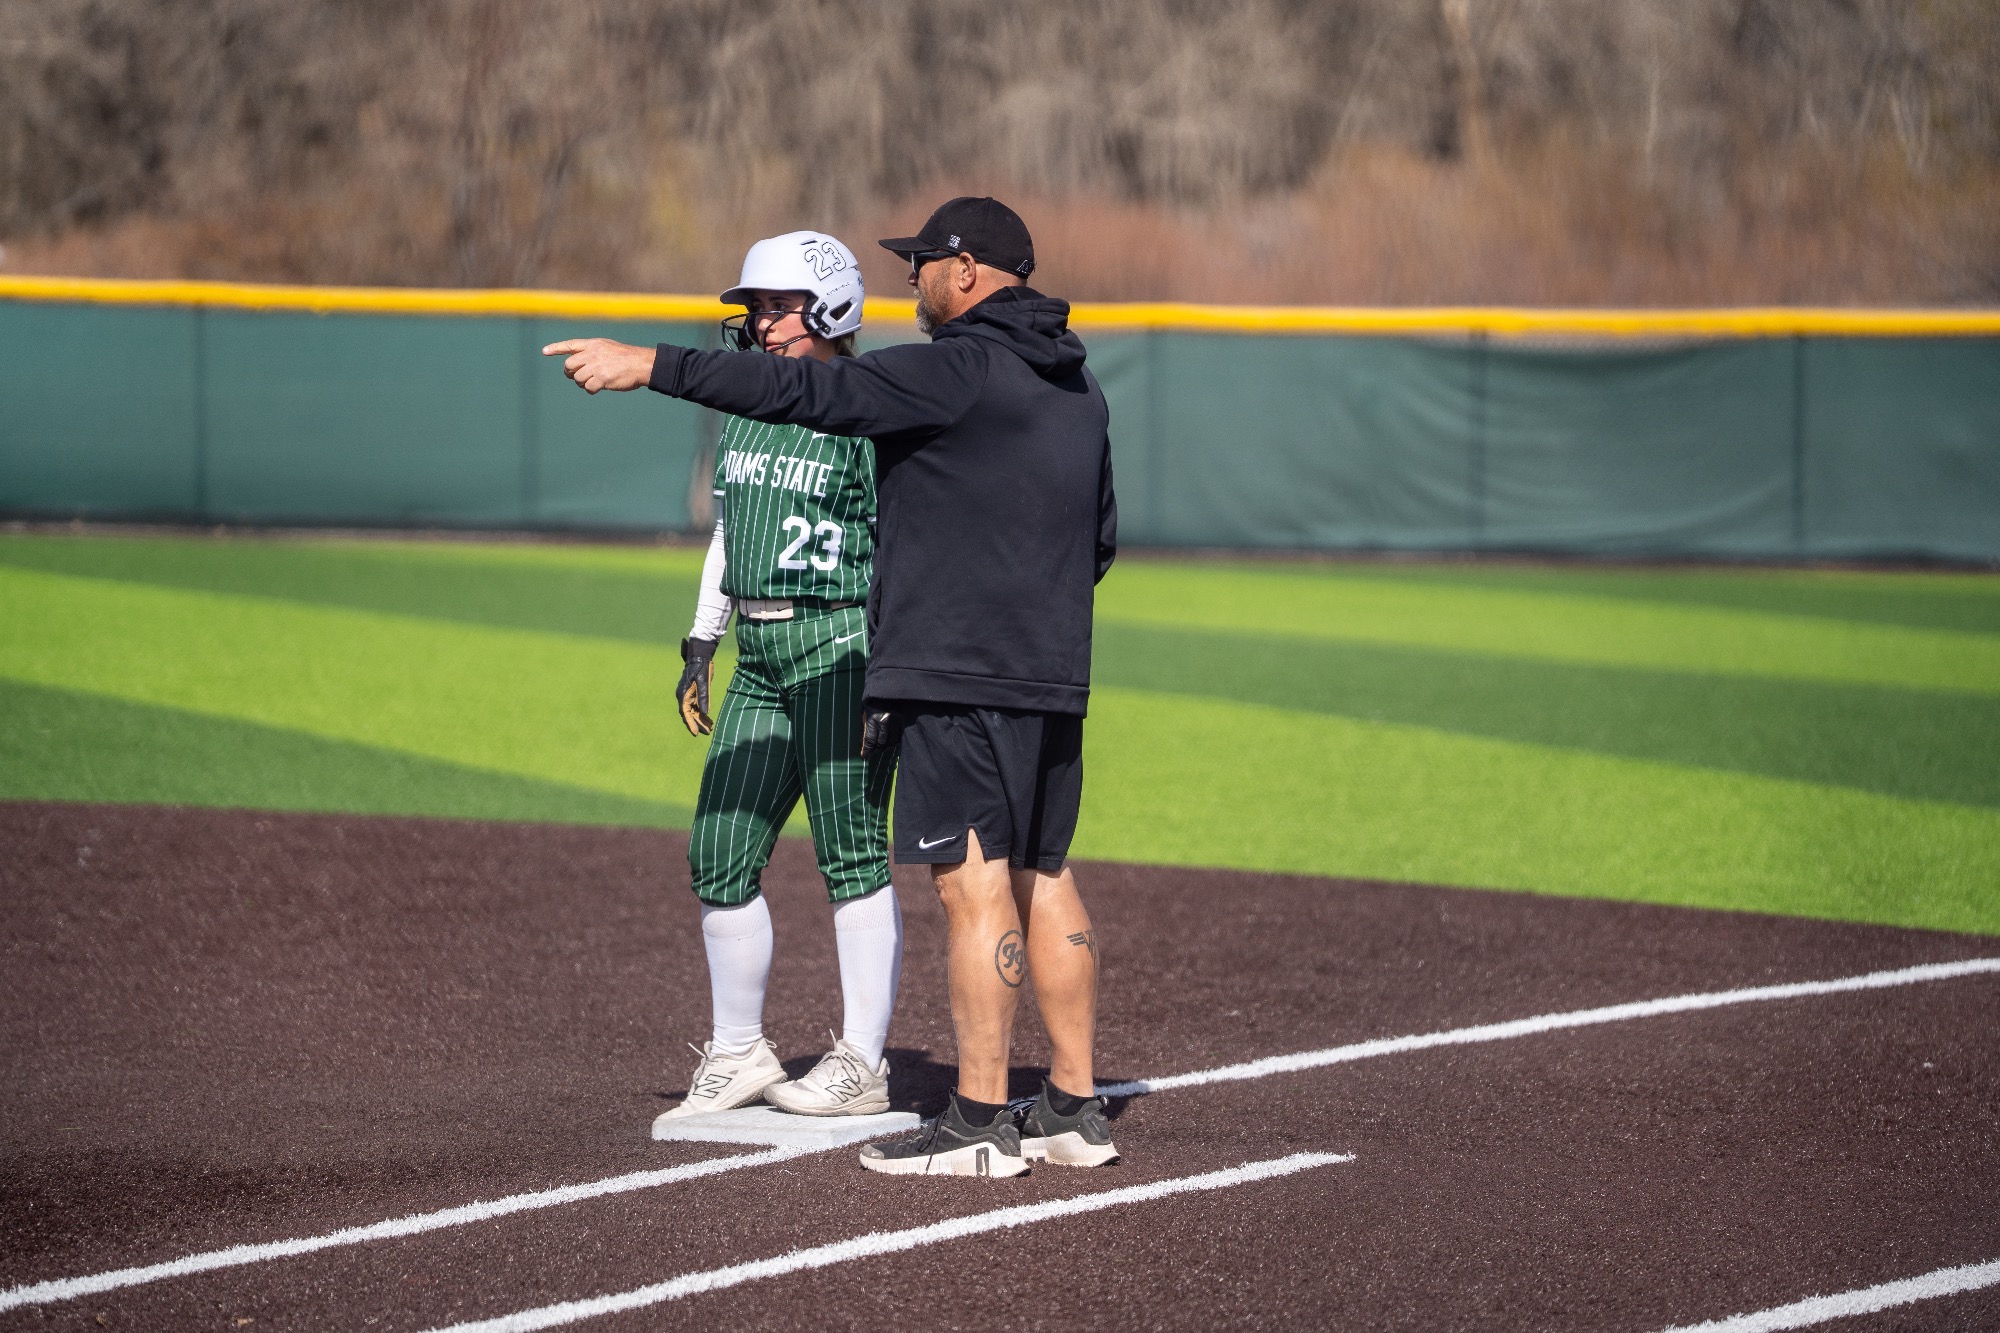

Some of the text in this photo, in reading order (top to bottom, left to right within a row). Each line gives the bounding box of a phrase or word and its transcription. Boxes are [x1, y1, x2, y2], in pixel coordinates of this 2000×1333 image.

[804, 241, 847, 281] 23
[770, 455, 833, 498] STATE
[778, 515, 842, 571] 23
